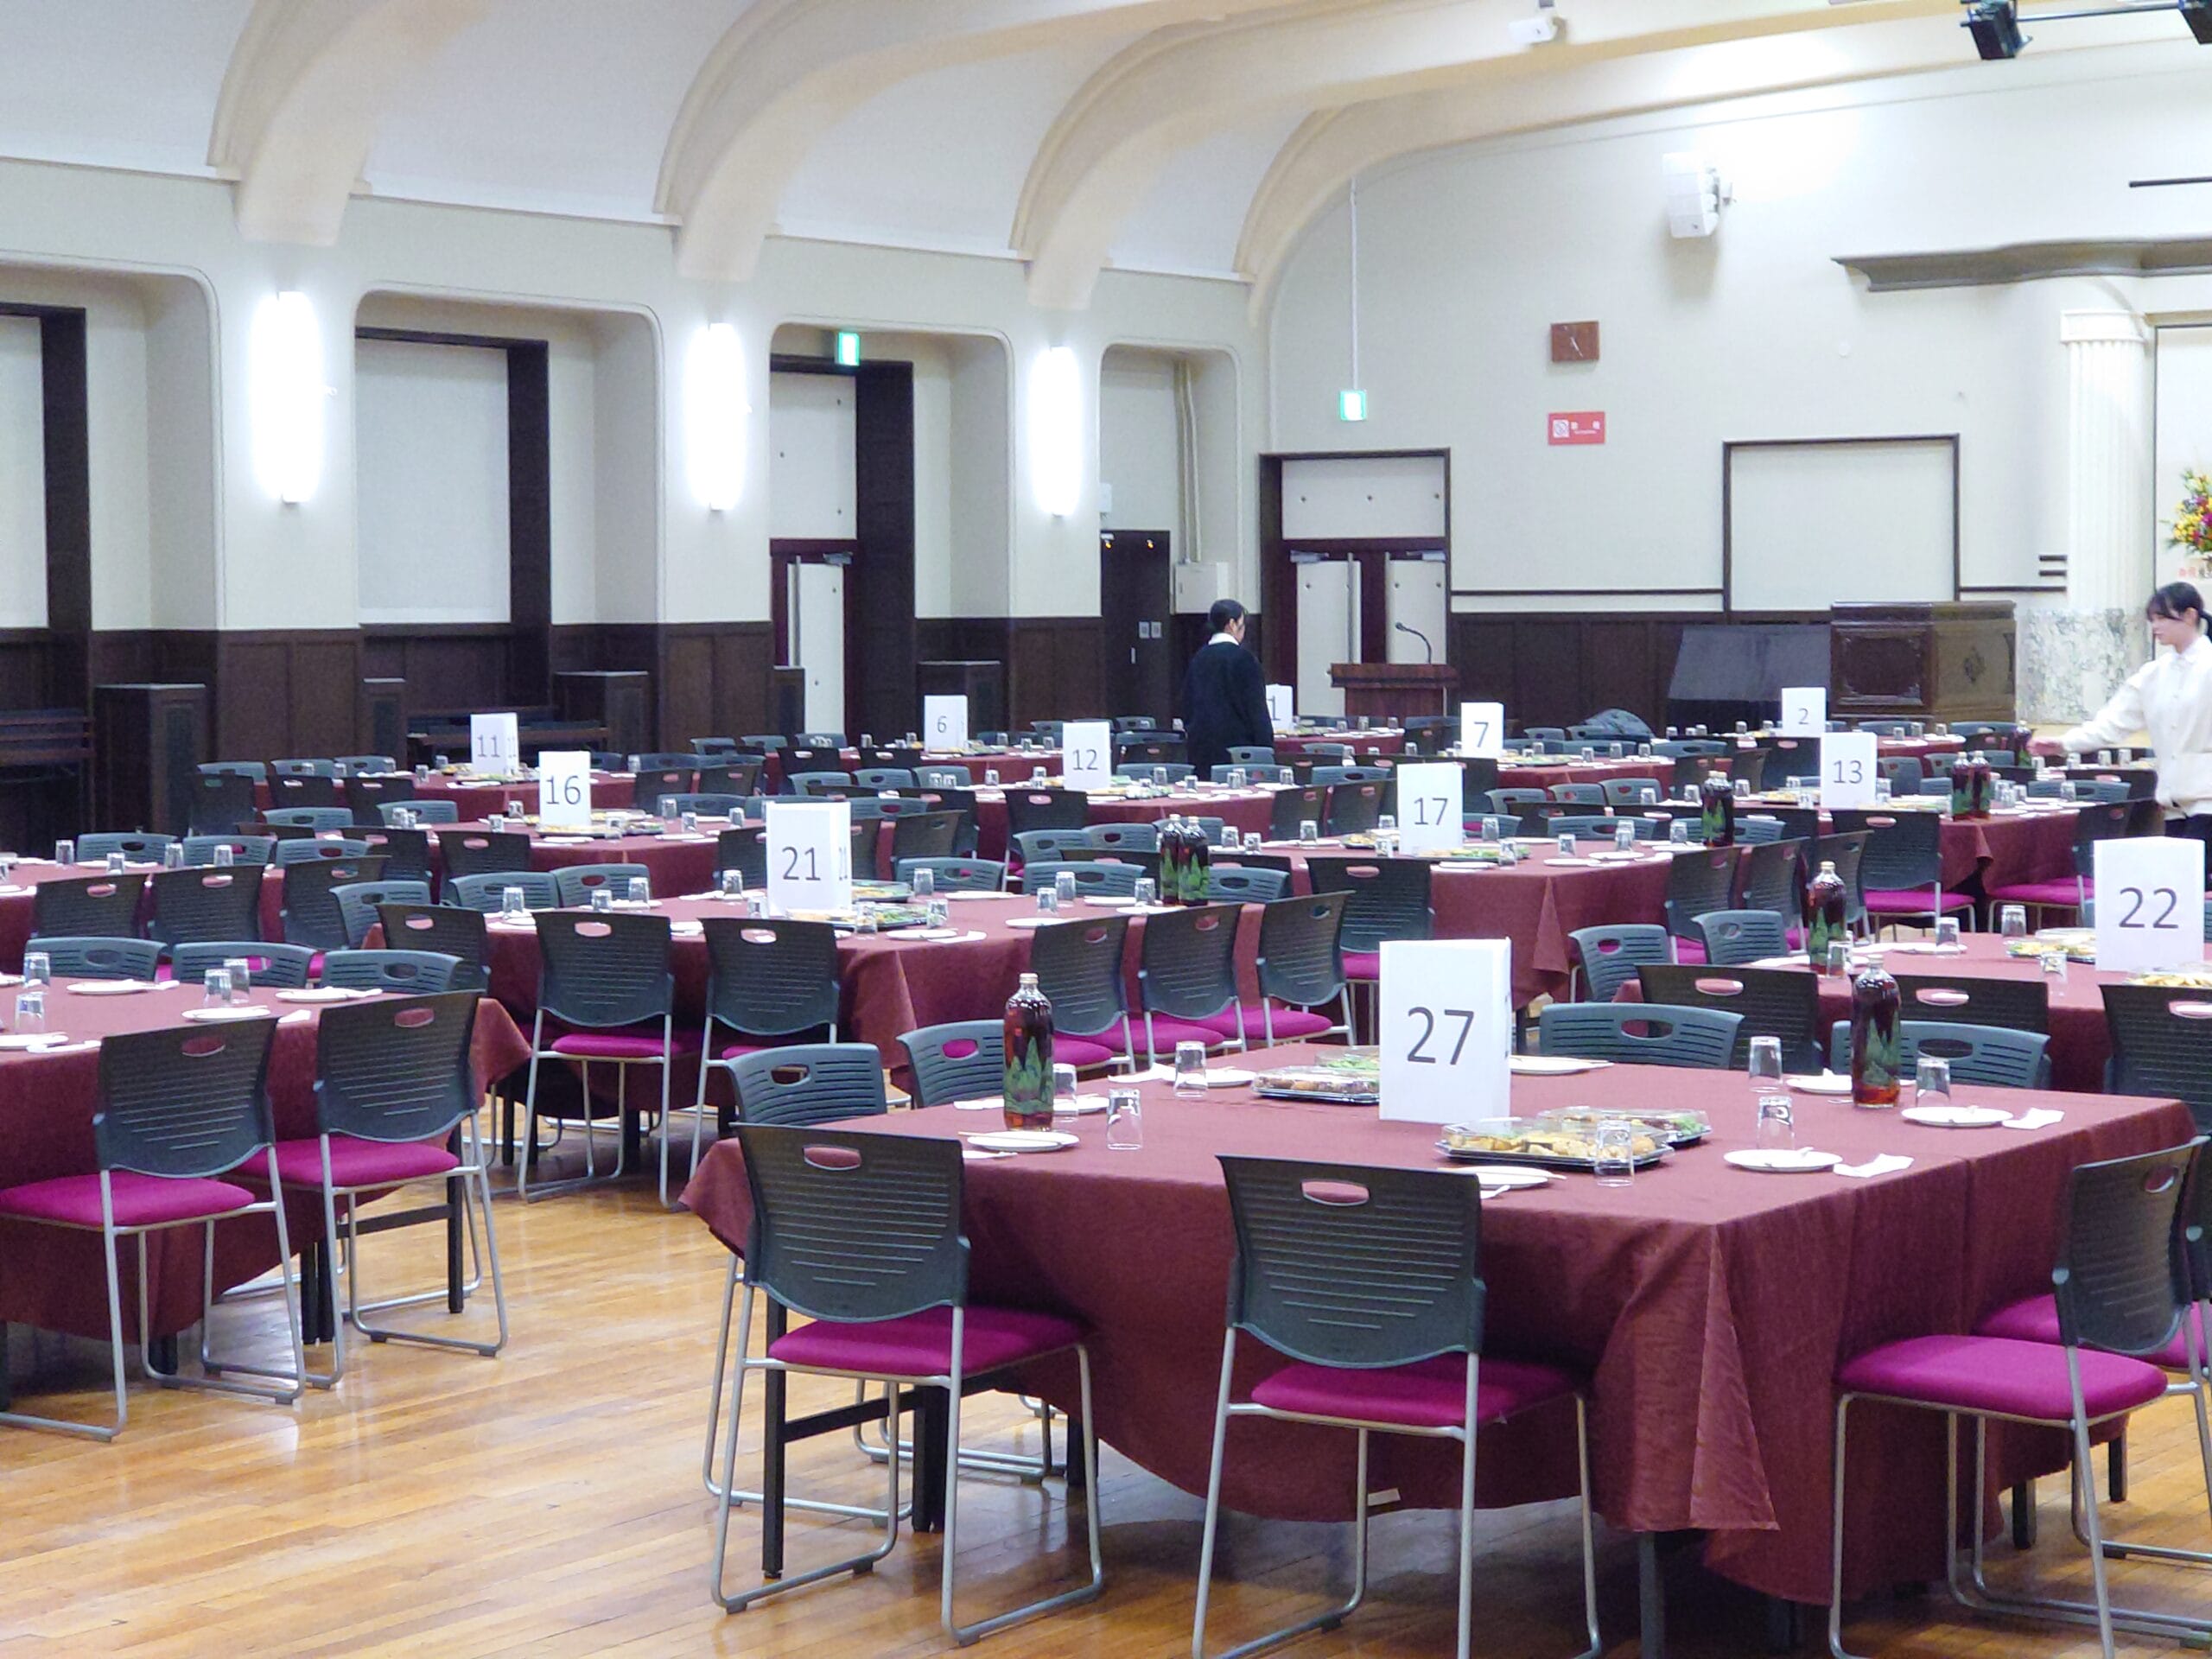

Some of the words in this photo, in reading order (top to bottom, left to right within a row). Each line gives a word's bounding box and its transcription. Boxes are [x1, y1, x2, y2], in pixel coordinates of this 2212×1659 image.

[937, 715, 947, 734] 6
[1798, 708, 1809, 726] 2
[477, 734, 501, 759] 11
[1473, 721, 1490, 748] 7
[1072, 748, 1098, 771] 12
[1833, 760, 1863, 785] 13
[546, 775, 582, 805] 16
[1414, 797, 1448, 826] 17
[782, 846, 822, 881] 21
[2118, 887, 2179, 930] 22
[1407, 1006, 1475, 1065] 27
